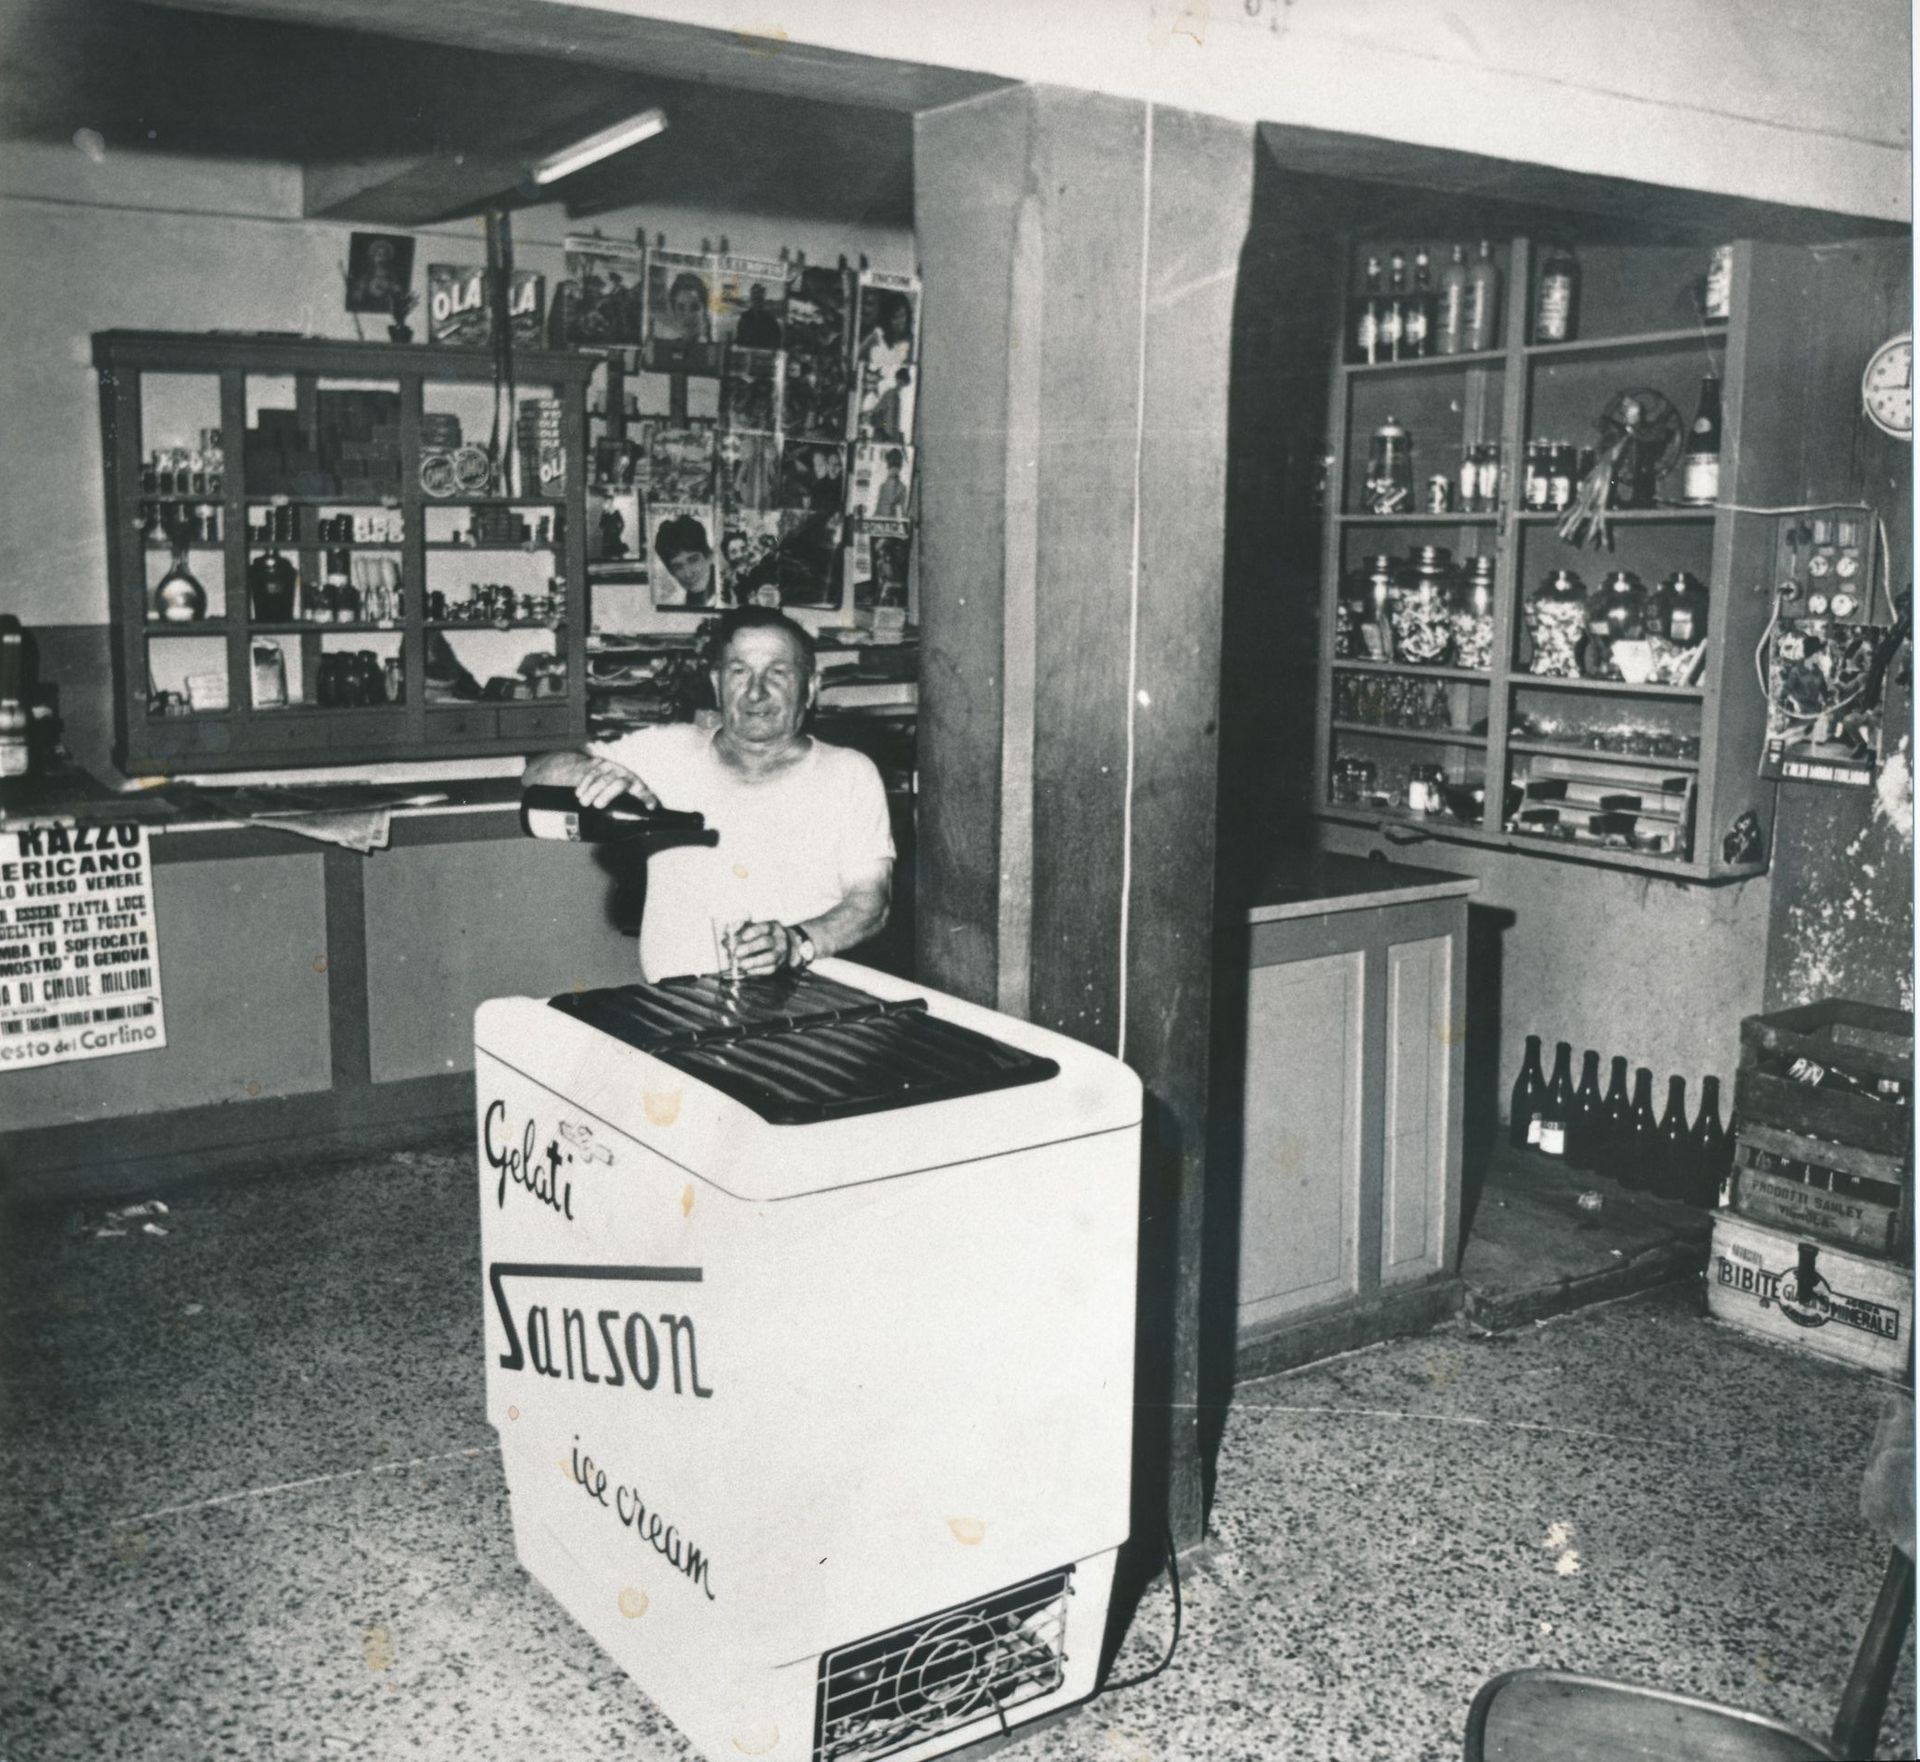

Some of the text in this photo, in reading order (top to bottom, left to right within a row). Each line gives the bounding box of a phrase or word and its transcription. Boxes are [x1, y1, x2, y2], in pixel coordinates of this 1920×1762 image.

[26, 879, 77, 897] VERSO
[86, 872, 143, 891] VENERE
[15, 904, 61, 922] ESSERE
[68, 900, 109, 917] FATTA
[116, 895, 146, 912] LUCE
[62, 918, 88, 935] PER
[39, 941, 56, 956] FU
[64, 931, 148, 953] SOFFOCATA
[75, 954, 89, 968] DI
[93, 947, 149, 966] GENOVA
[20, 981, 34, 1004] DI
[43, 975, 91, 1001] CINQUE
[101, 967, 152, 994] MILIONI
[54, 1038, 77, 1053] del
[80, 1023, 157, 1050] Carlino
[484, 1099, 574, 1221] Gelati
[1720, 1260, 1781, 1300] BIBITE
[489, 1262, 713, 1399] Sanson
[1830, 1301, 1895, 1336] MINERALE
[571, 1435, 715, 1600] ice cream
